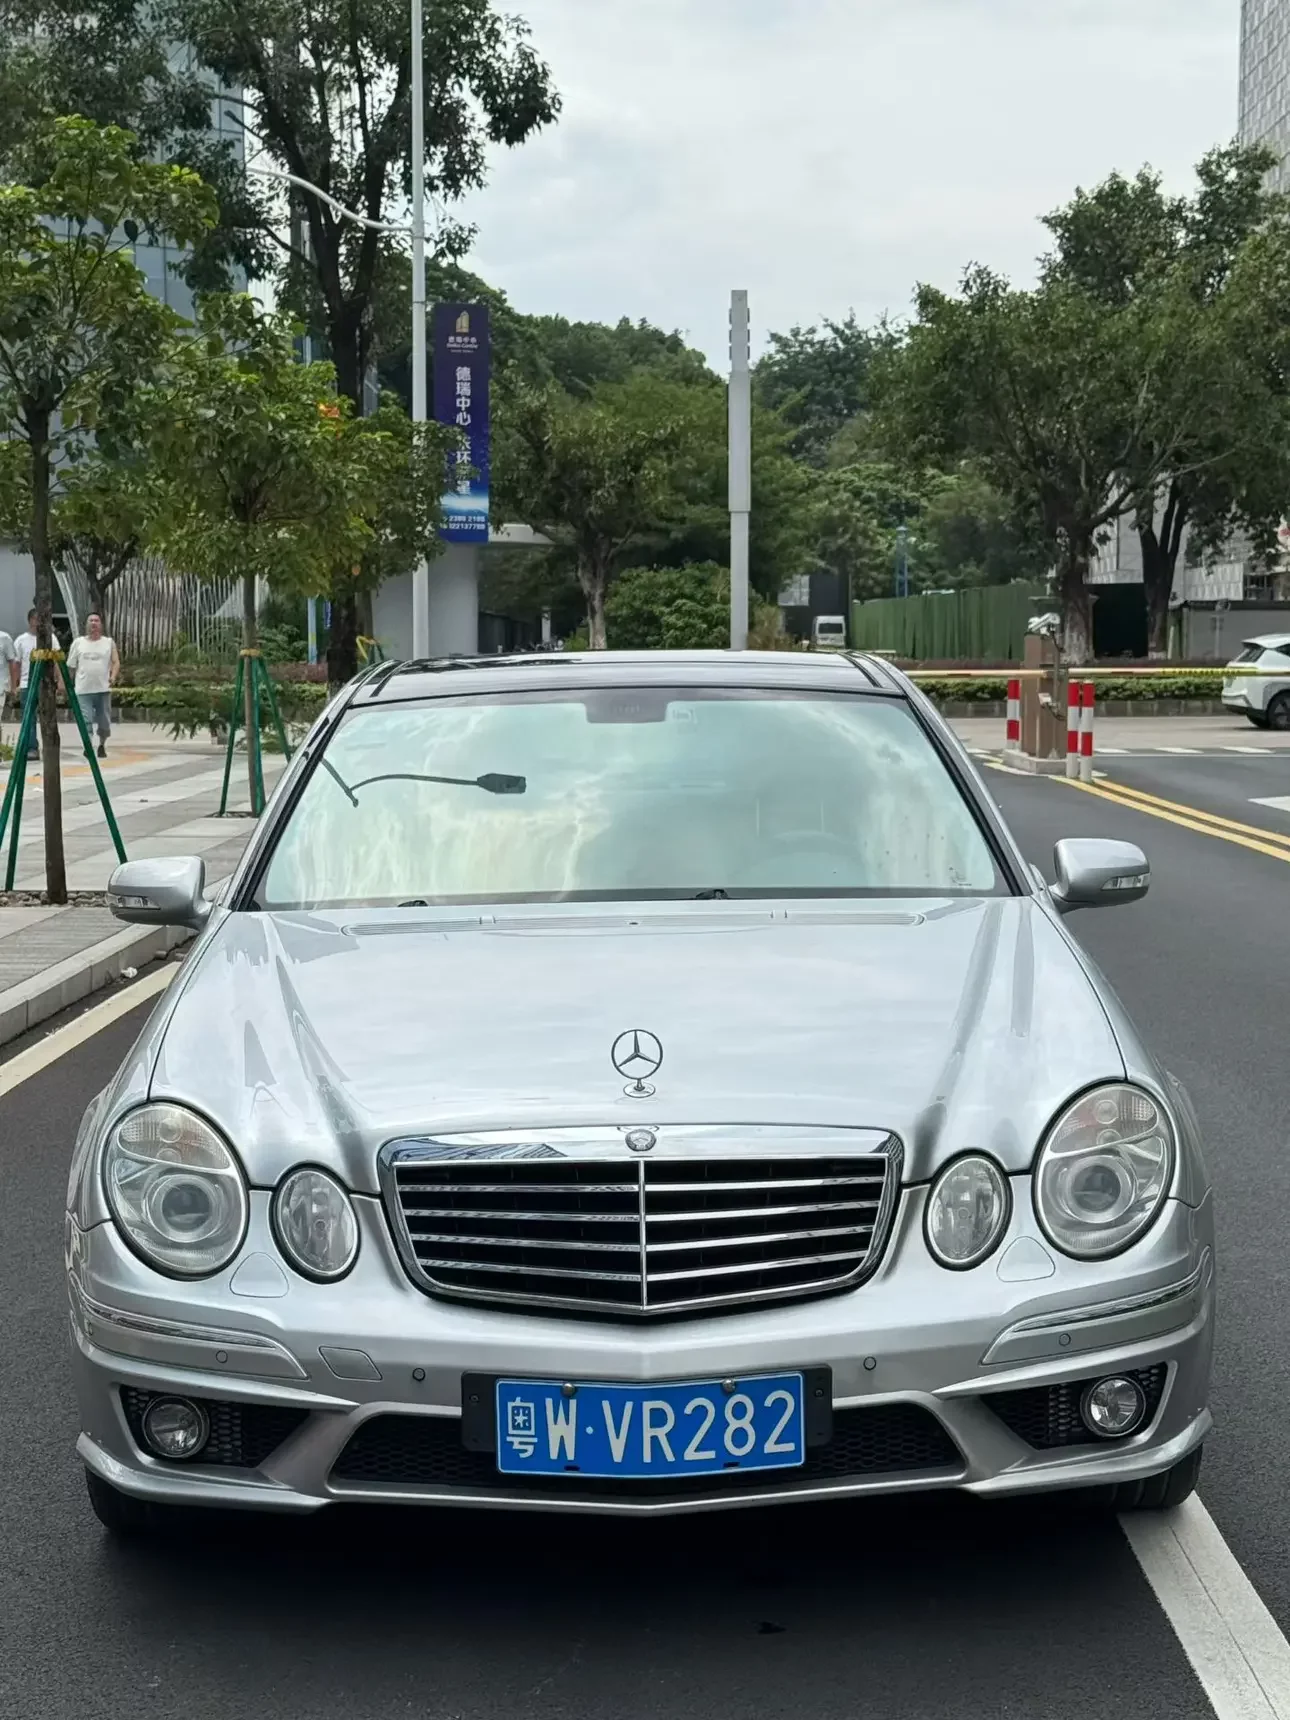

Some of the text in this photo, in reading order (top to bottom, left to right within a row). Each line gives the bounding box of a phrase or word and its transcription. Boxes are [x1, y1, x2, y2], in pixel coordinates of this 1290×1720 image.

[456, 366, 472, 426] 德瑞中心
[506, 1389, 796, 1463] 粤W·VR282
